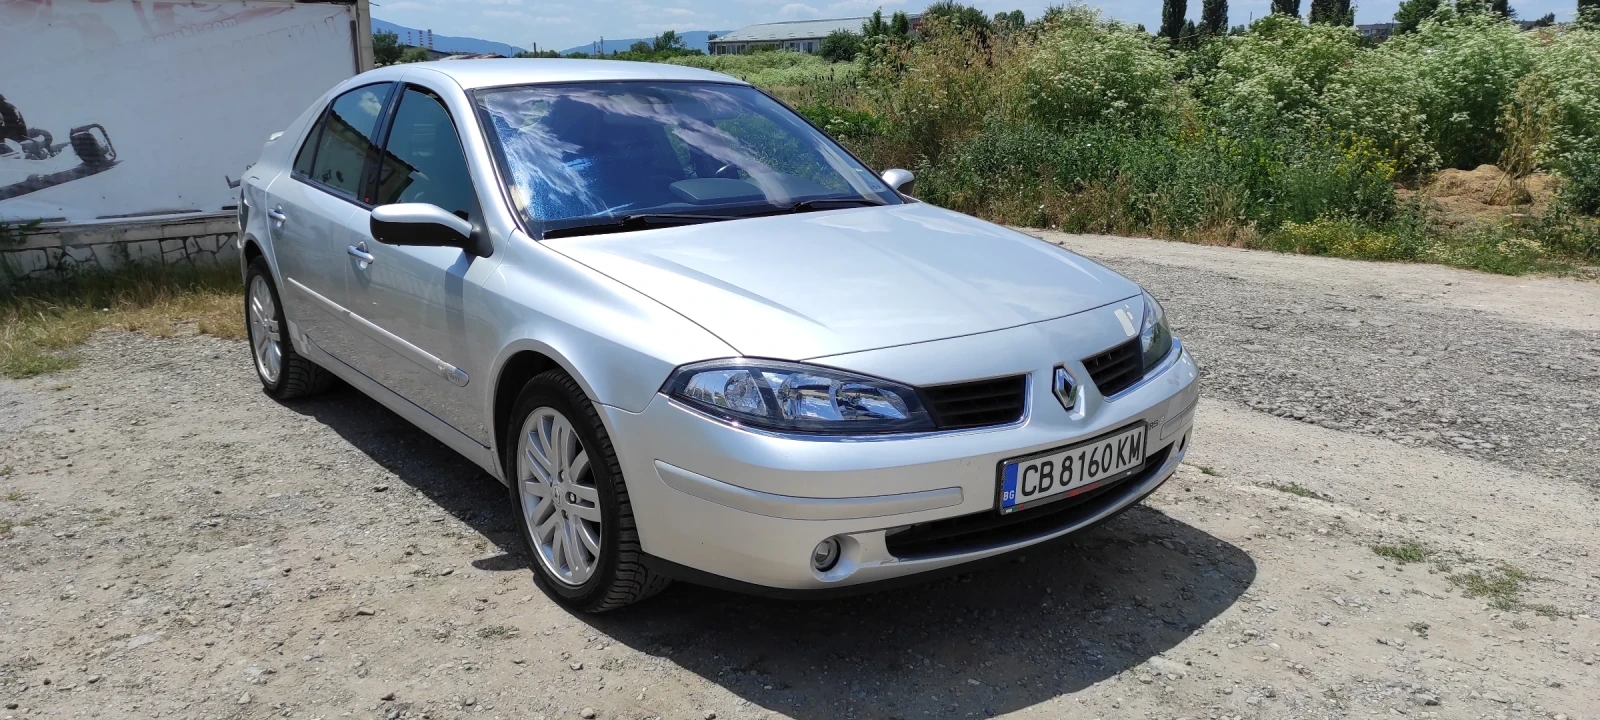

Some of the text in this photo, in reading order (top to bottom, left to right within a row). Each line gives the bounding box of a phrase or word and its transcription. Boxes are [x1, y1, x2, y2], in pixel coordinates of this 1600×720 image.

[1021, 460, 1054, 496] CB
[1059, 443, 1113, 486] 8160
[1115, 431, 1142, 469] KM
[1003, 490, 1015, 501] BG
